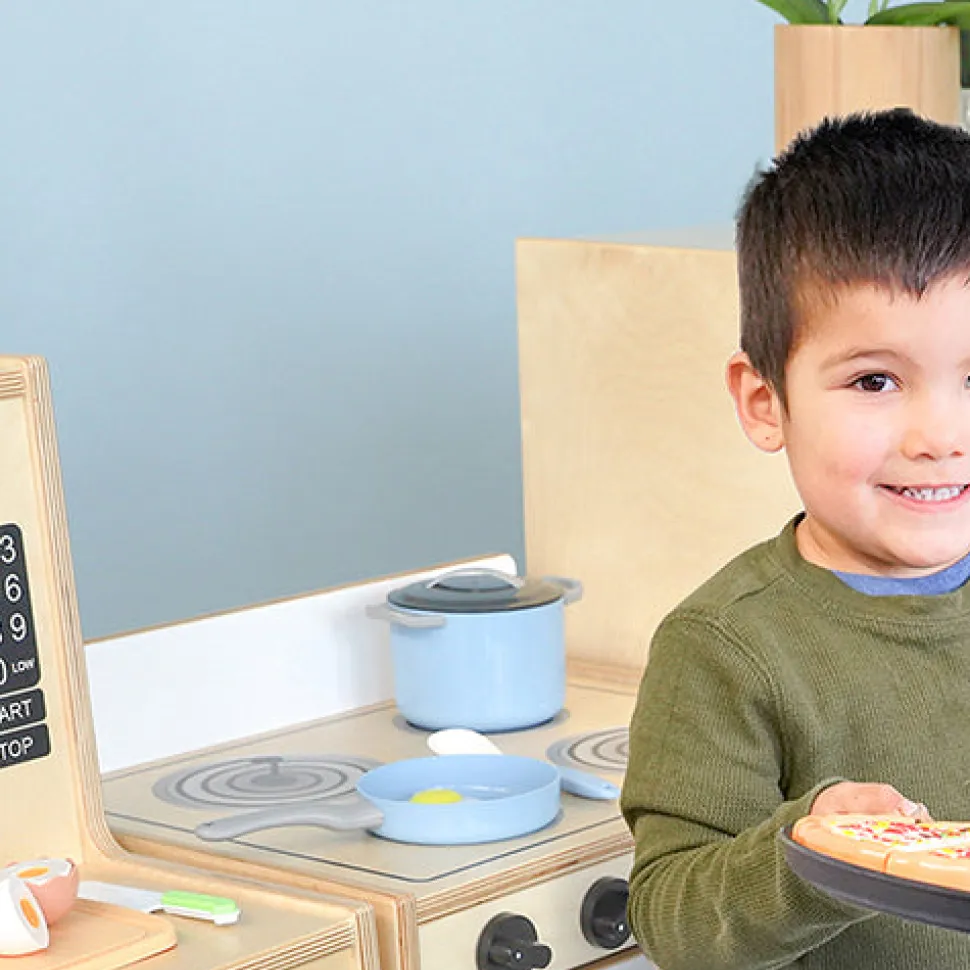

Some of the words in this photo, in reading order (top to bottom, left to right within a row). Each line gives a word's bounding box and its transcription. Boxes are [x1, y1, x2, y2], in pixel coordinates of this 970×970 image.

[0, 534, 17, 564] 3
[5, 573, 22, 602] 6
[10, 612, 27, 641] 9
[11, 657, 36, 673] LOW
